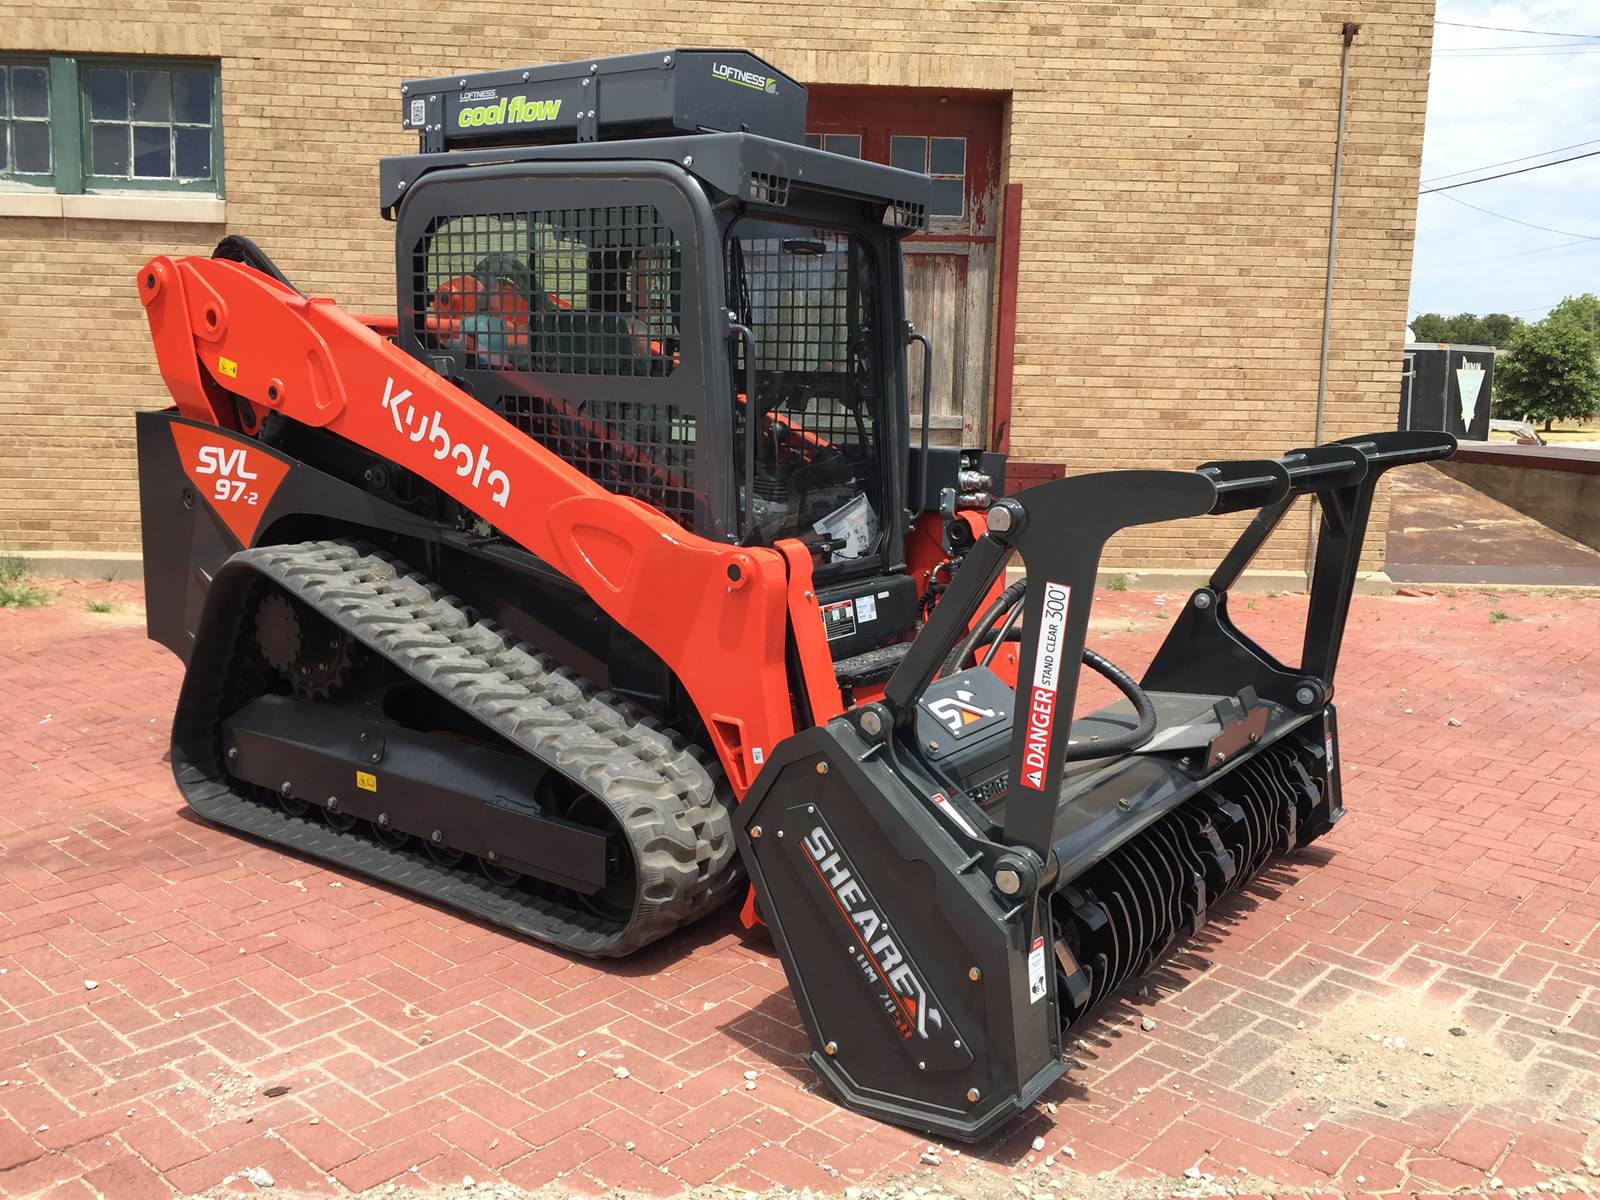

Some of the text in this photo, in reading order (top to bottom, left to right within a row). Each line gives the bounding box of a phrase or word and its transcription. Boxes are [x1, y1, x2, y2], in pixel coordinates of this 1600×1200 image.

[712, 62, 766, 87] LOFTNESS
[460, 89, 497, 101] LOFTNESS
[458, 96, 562, 127] cool flow
[381, 376, 511, 508] Kubota
[195, 445, 258, 480] SVL
[214, 478, 259, 505] 97-2
[1044, 624, 1059, 654] CLEAR
[1041, 654, 1055, 686] STAND
[1026, 689, 1054, 768] DANGER
